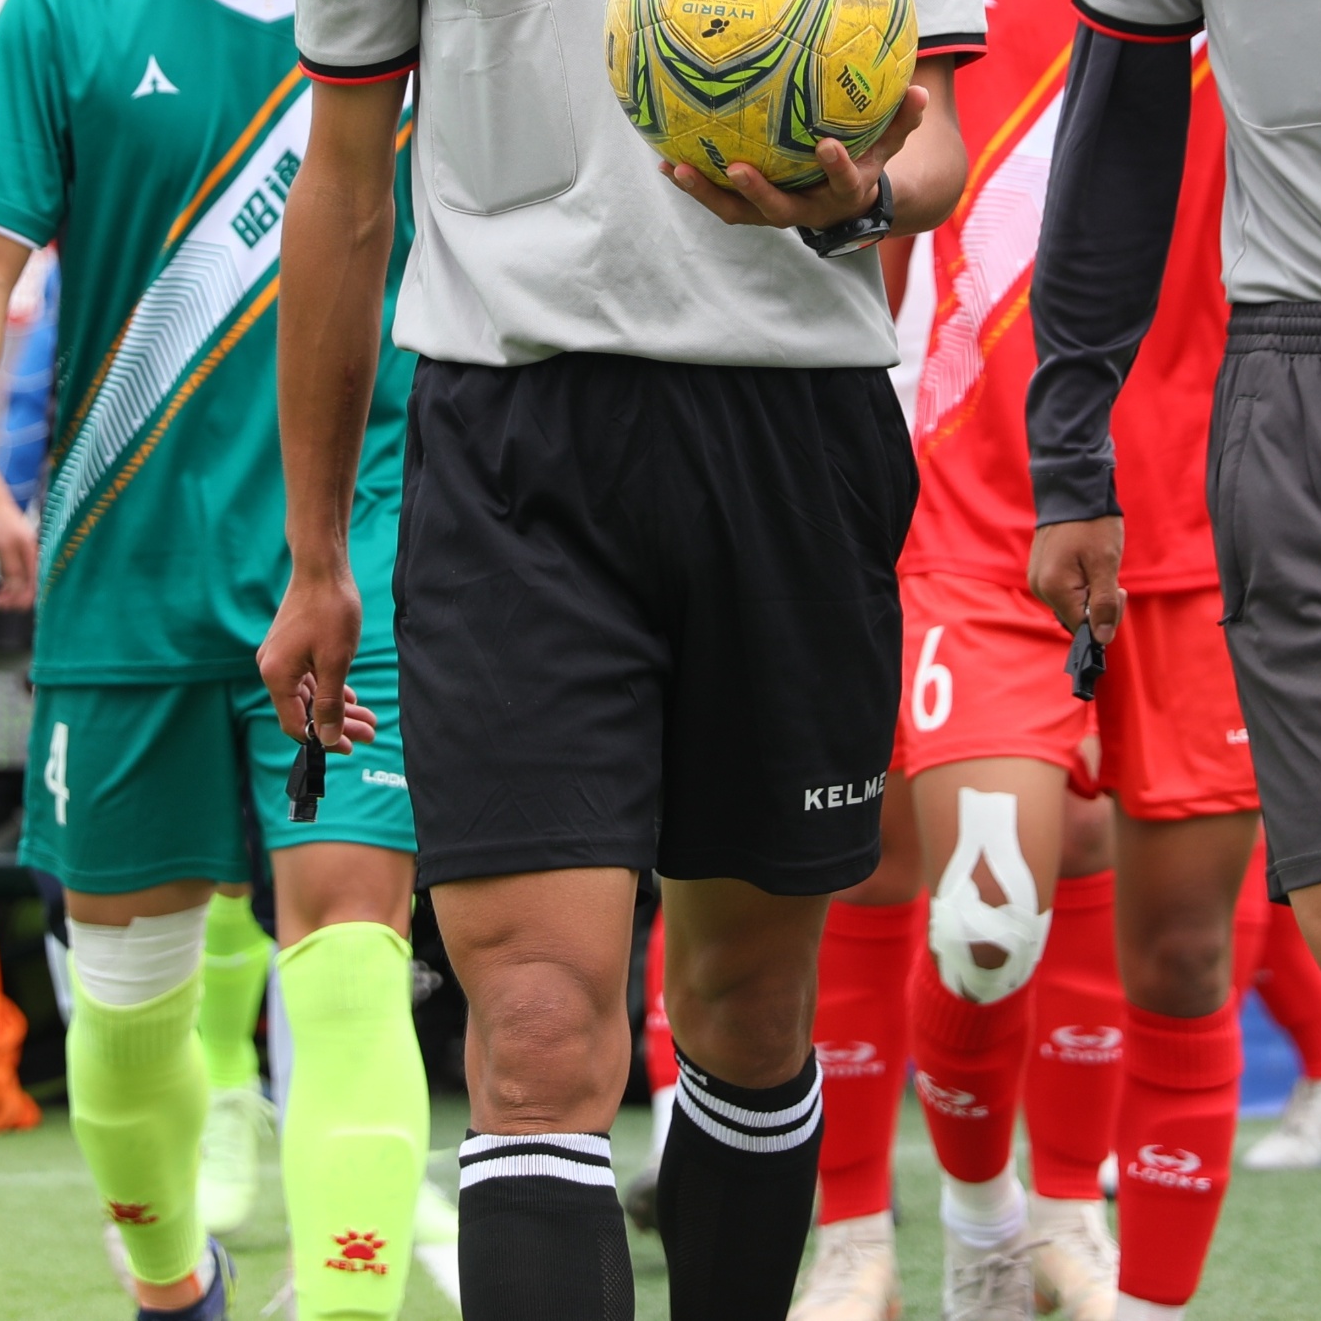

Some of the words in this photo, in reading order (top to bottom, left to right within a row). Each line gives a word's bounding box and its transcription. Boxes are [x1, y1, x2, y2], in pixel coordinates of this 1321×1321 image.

[682, 2, 755, 20] HYBRID
[836, 64, 872, 114] FUTSAL
[911, 624, 953, 733] 6
[45, 721, 69, 827] 4
[804, 770, 887, 811] KELME
[1127, 1162, 1212, 1193] LOOKS
